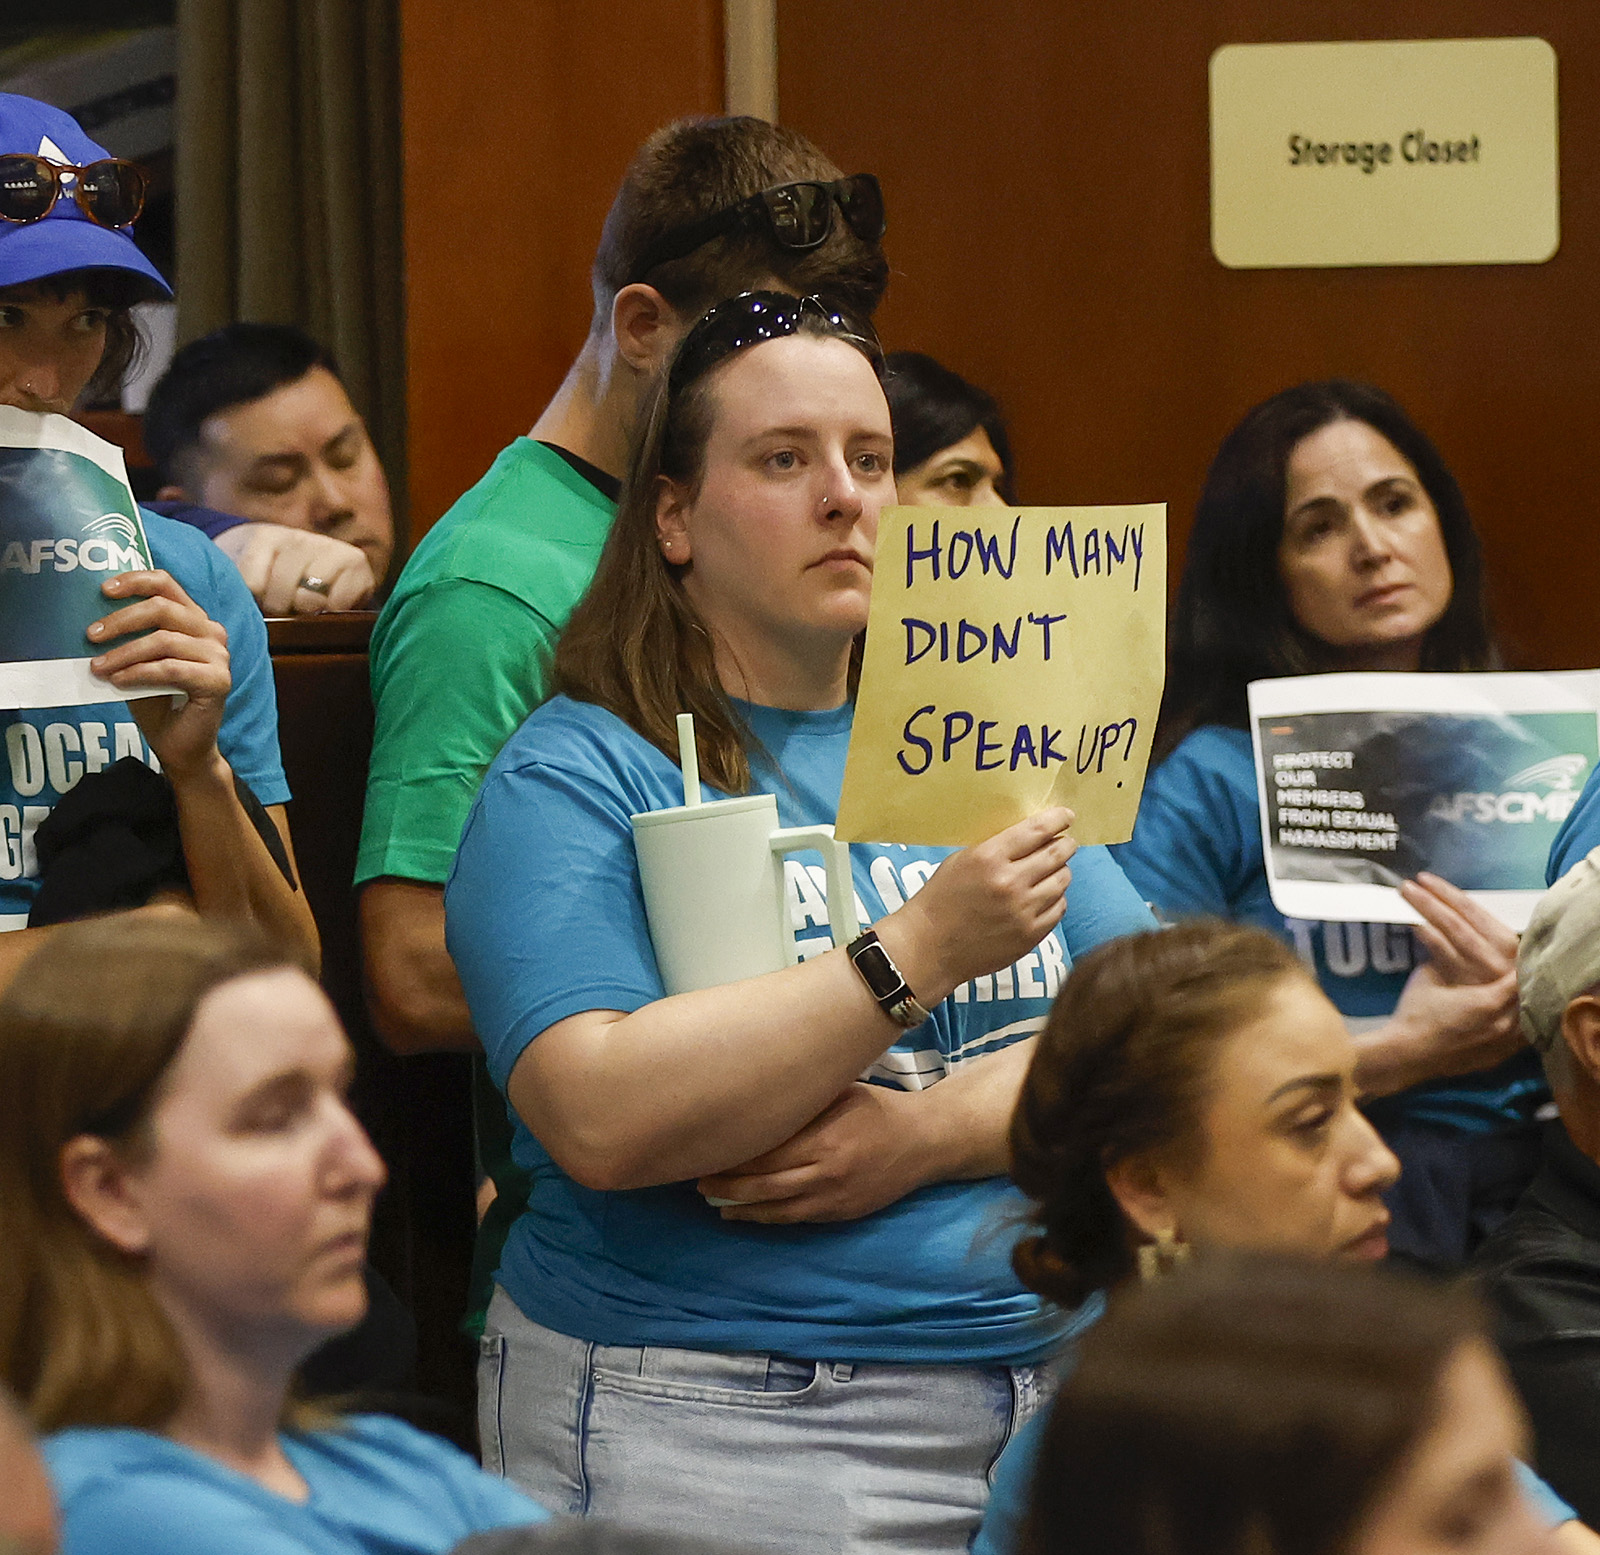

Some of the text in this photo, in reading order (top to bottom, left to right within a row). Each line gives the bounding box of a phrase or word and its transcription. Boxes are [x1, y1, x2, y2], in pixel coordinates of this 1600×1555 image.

[1288, 129, 1480, 175] Storage Closet
[905, 515, 1144, 592] HOW MANY
[901, 612, 1067, 666] DIDN'T
[4, 722, 164, 797] OCEA
[897, 705, 1137, 788] SPEAK UP?
[1274, 770, 1317, 788] OUR
[1278, 807, 1330, 827] FROM
